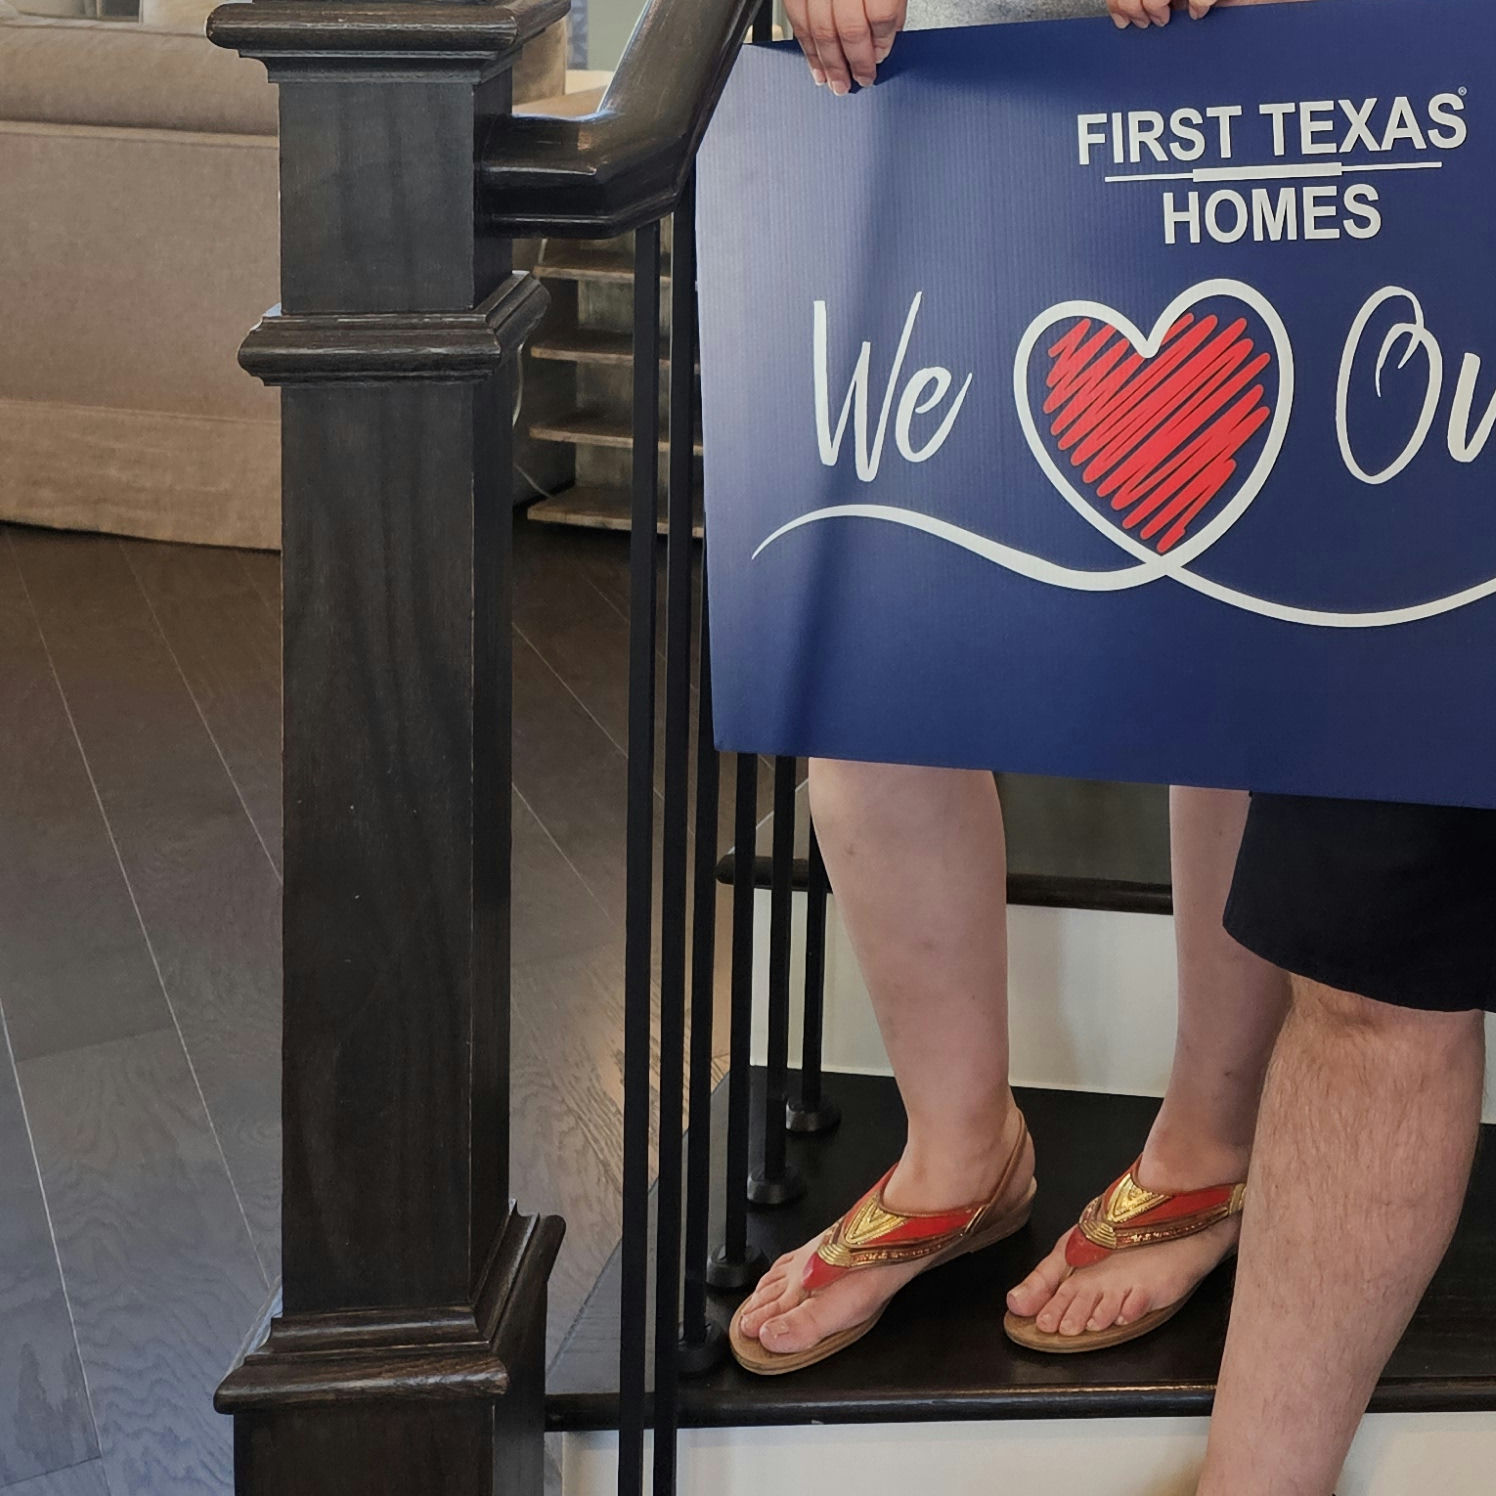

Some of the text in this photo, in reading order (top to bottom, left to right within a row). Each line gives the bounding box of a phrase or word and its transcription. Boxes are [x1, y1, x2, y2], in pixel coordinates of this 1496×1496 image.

[1077, 103, 1242, 165] FIRST
[1162, 183, 1382, 244] HOMES
[814, 291, 973, 482] We
